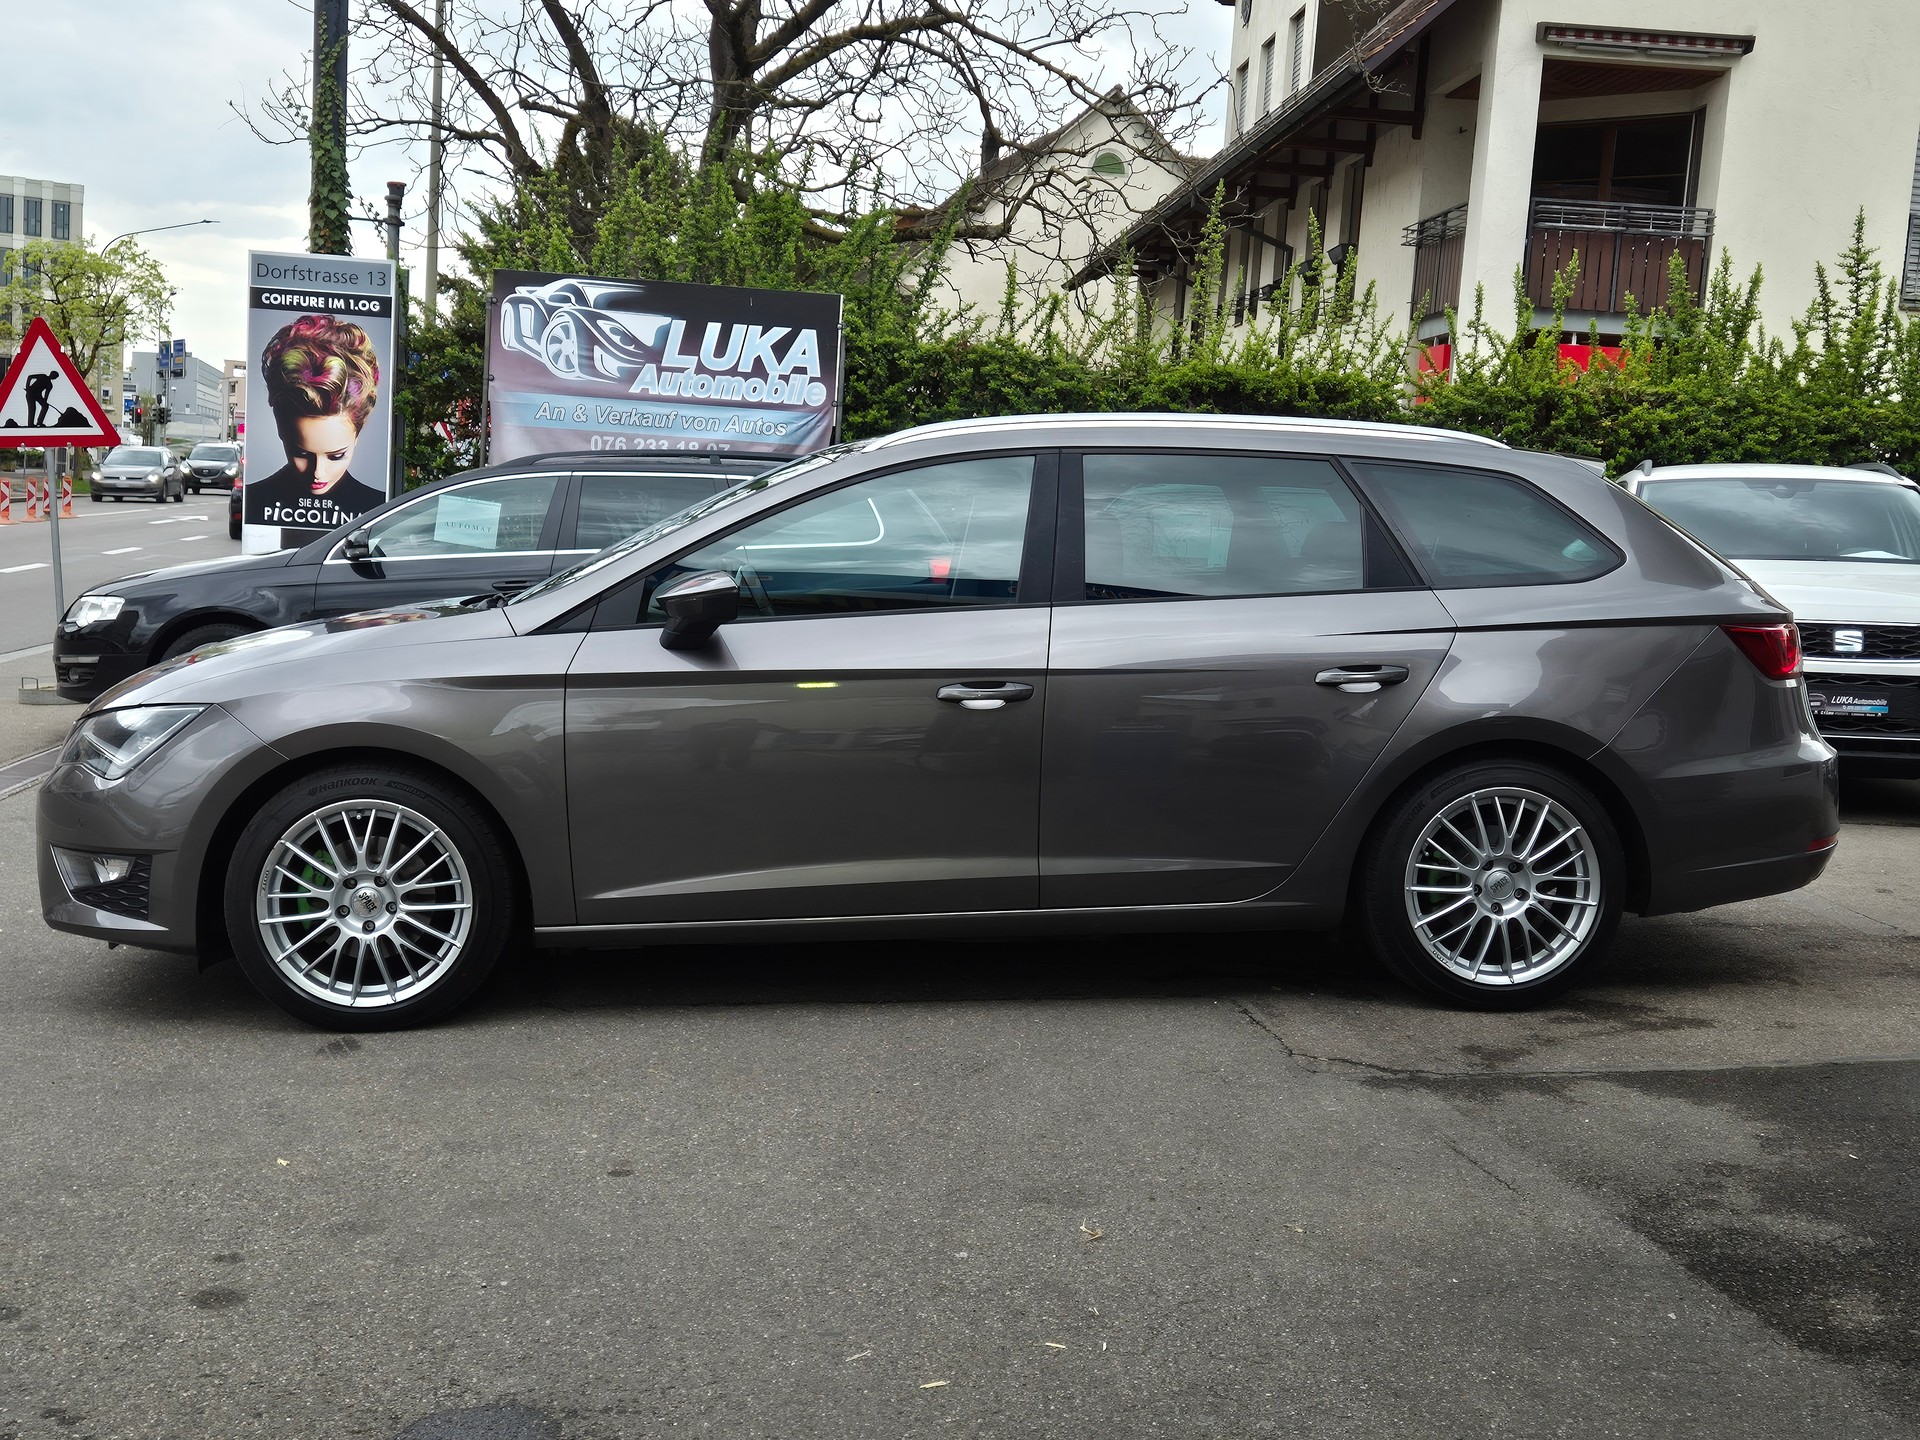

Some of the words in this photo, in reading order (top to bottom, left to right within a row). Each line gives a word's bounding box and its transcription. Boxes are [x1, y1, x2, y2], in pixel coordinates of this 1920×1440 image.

[256, 263, 359, 285] Dorfstrasse
[367, 271, 386, 287] 13
[261, 293, 325, 309] COIFFURE
[328, 297, 345, 310] IM
[349, 299, 380, 312] 1.OG
[661, 319, 821, 378] LUKA
[629, 363, 827, 407] Automobile
[534, 402, 566, 421] An
[572, 404, 588, 424] &
[595, 405, 678, 428] Verkauf
[681, 415, 720, 432] von
[723, 414, 788, 437] Autos
[590, 435, 627, 451] 076
[298, 498, 312, 508] SIE
[313, 499, 321, 508] &
[322, 499, 333, 509] ER
[445, 521, 491, 533] AUTOMAT
[1831, 695, 1853, 704] LUKA
[1852, 698, 1888, 706] Automobile
